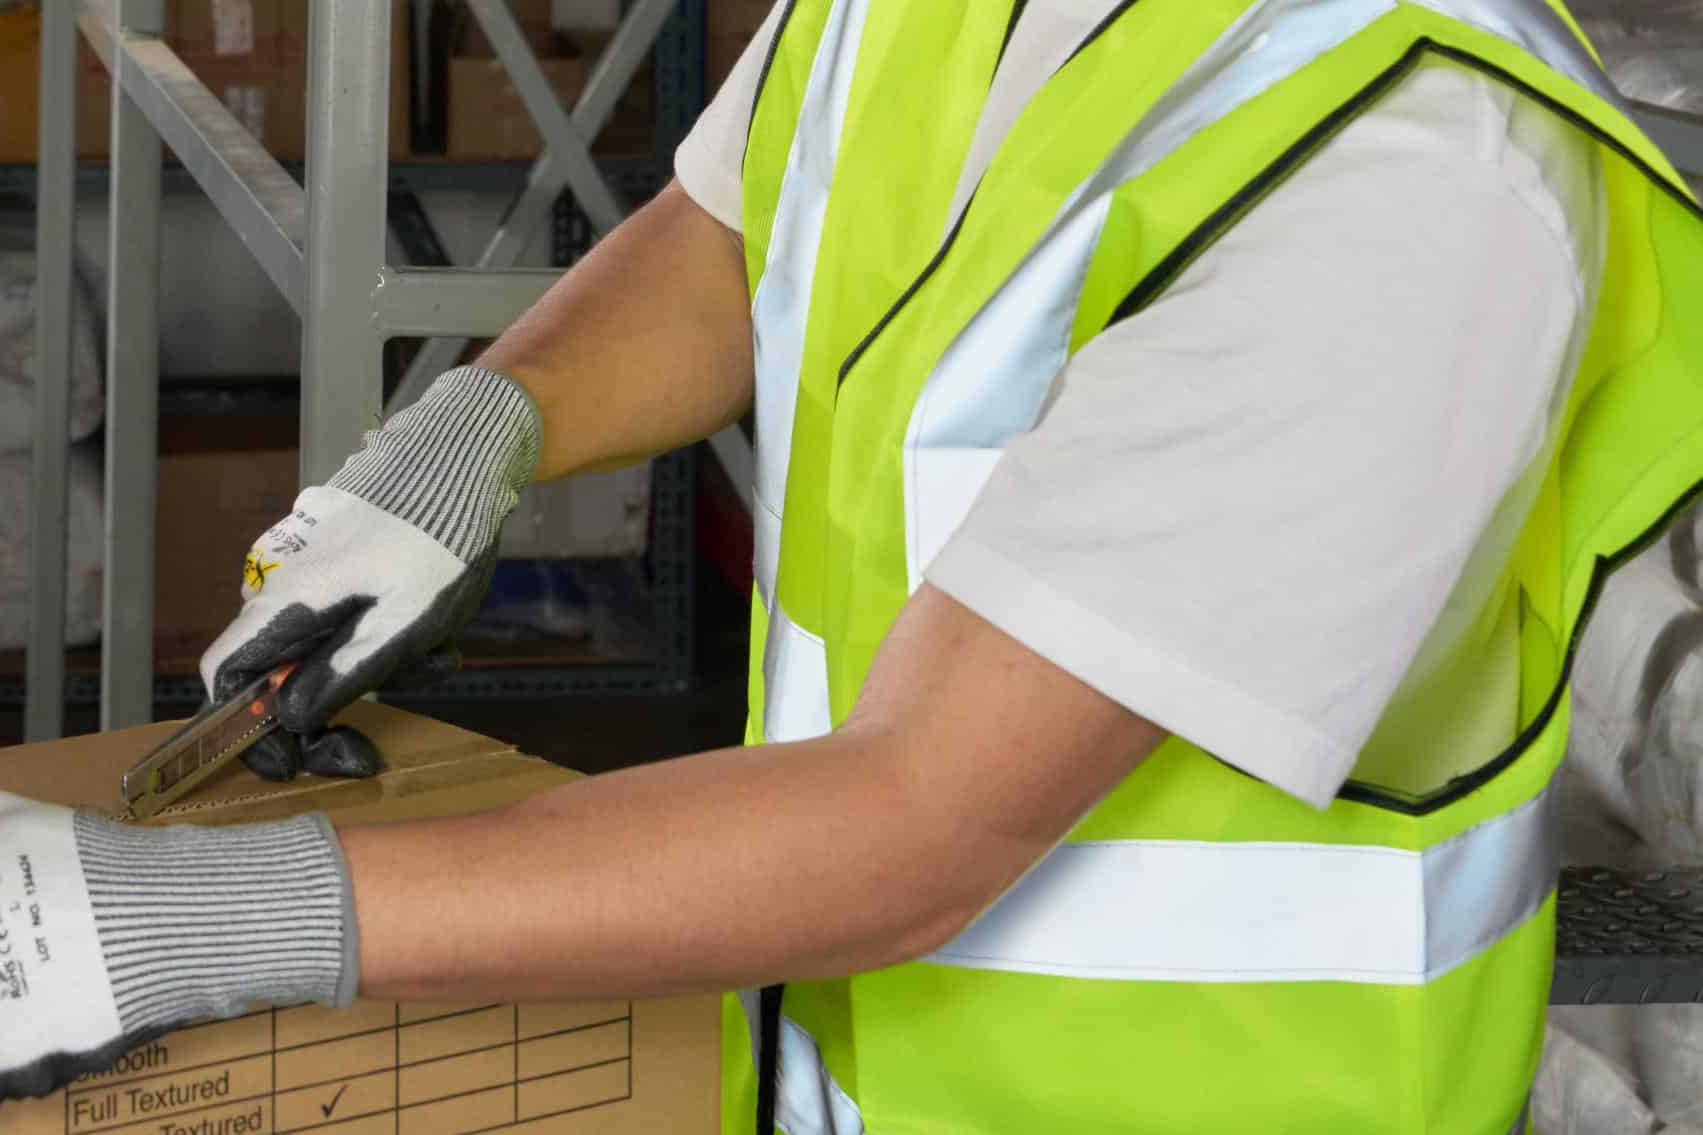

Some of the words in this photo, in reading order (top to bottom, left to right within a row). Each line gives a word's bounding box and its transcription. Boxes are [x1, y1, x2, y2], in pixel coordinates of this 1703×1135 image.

[36, 937, 50, 962] LOT
[74, 1095, 118, 1126] Full
[125, 1070, 230, 1113] Textured
